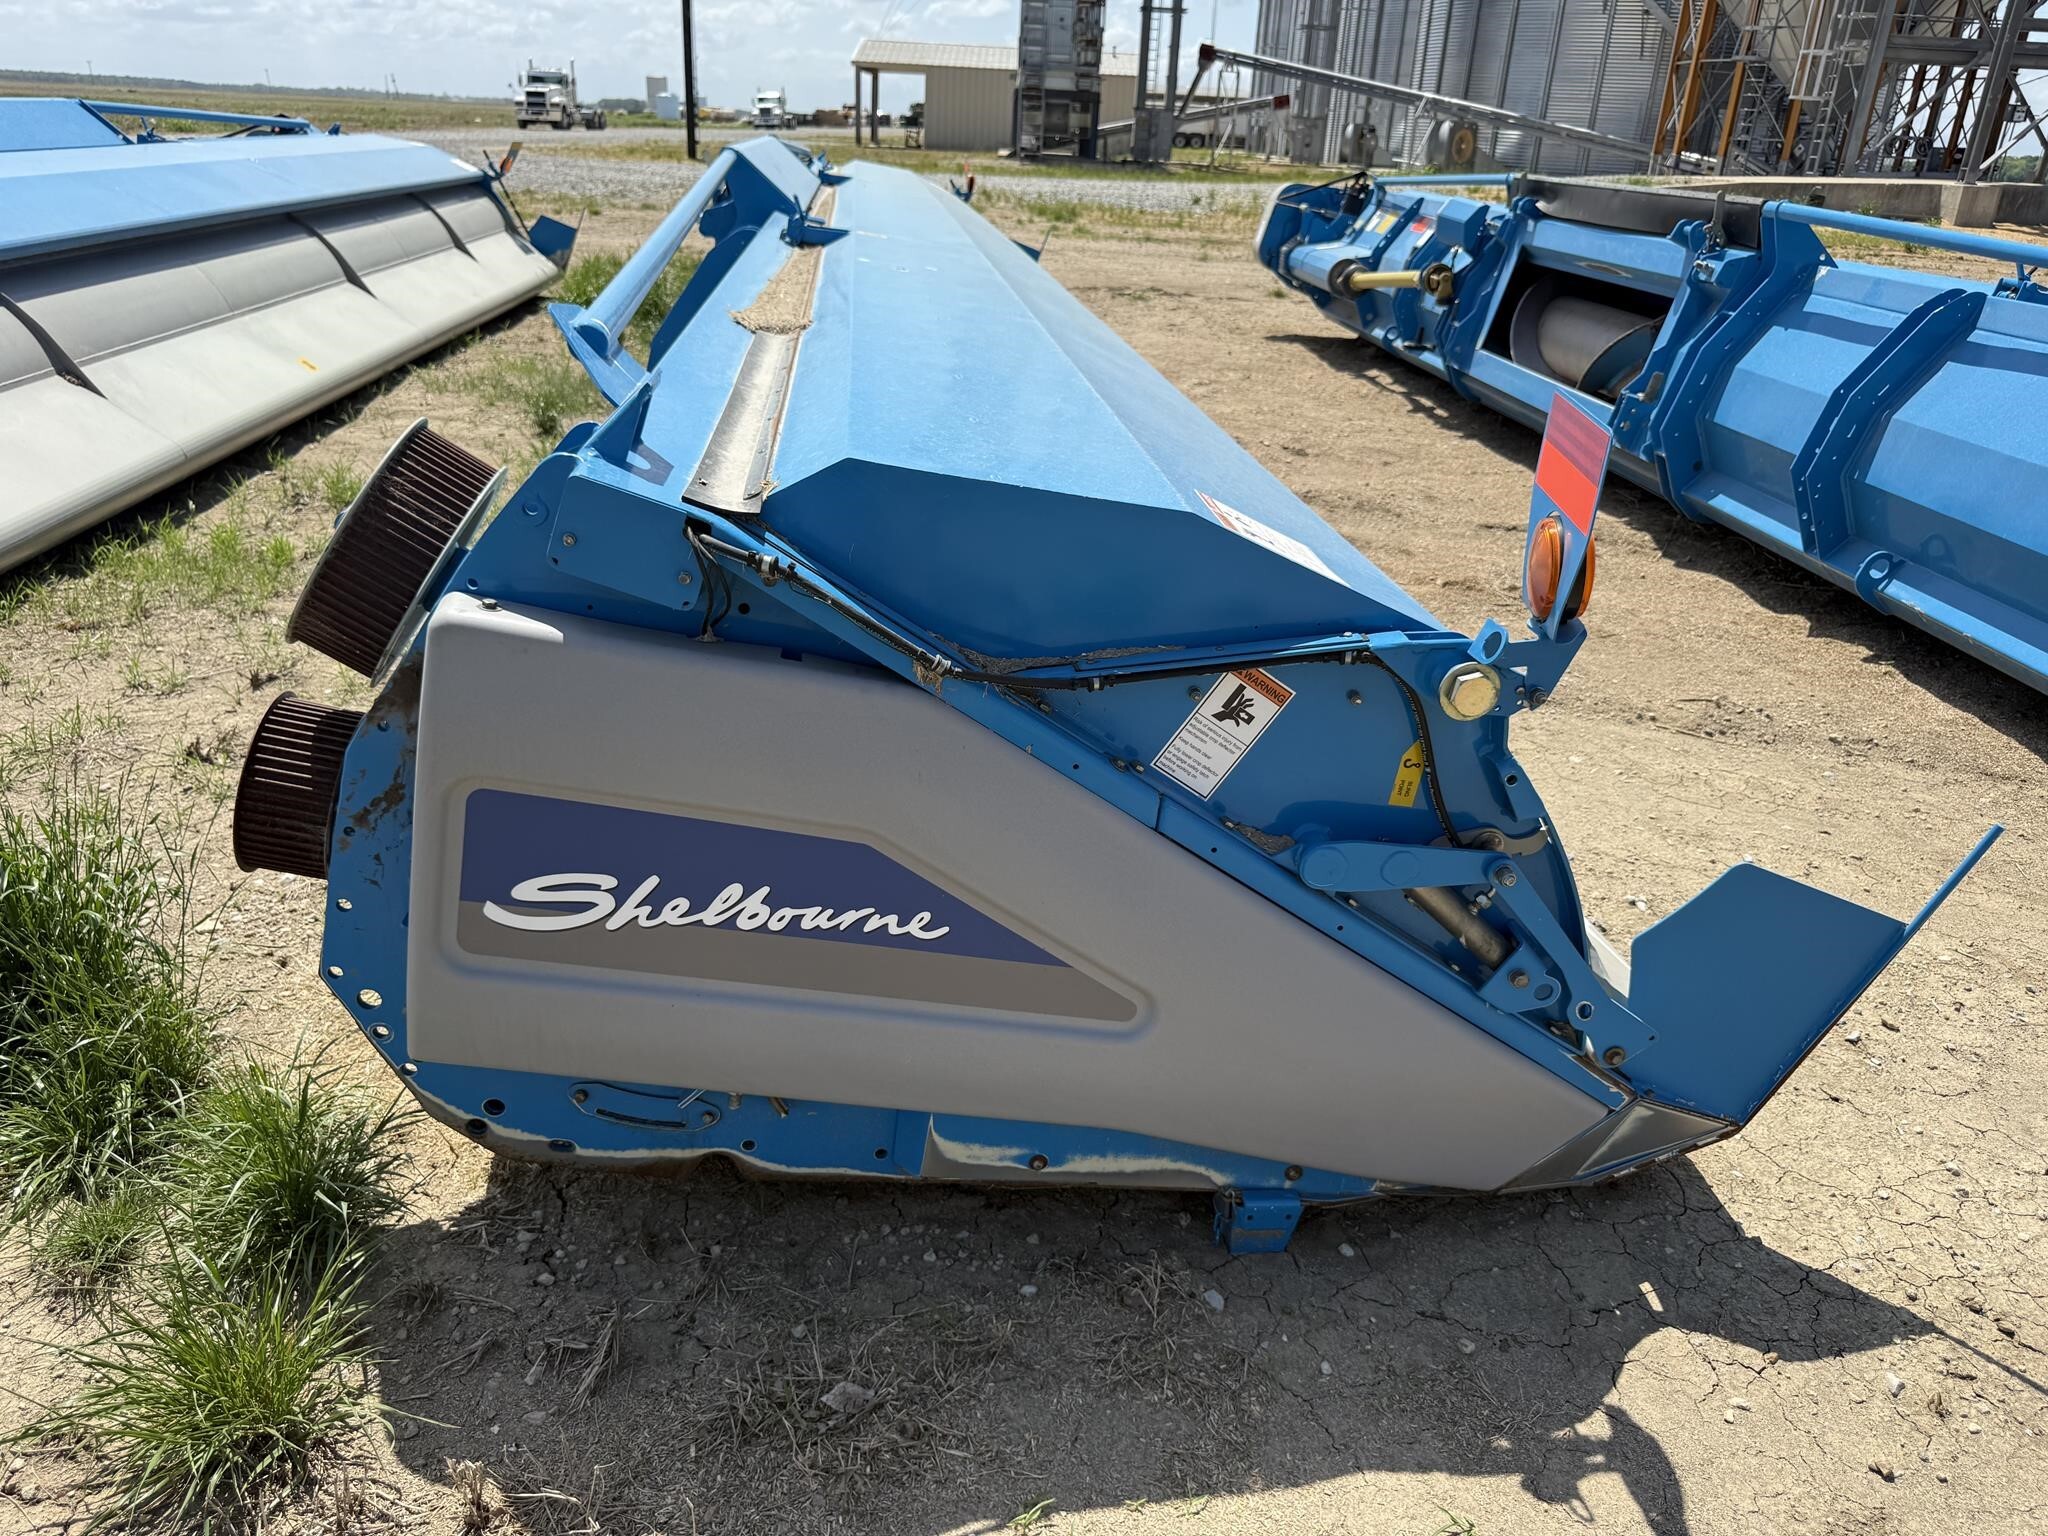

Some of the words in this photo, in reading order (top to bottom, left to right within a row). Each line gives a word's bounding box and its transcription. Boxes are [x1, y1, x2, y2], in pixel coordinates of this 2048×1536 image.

[1244, 669, 1287, 703] WARNING
[1184, 727, 1207, 744] mechanism
[1192, 716, 1203, 724] Risk
[1206, 726, 1222, 737] serious
[1220, 735, 1233, 745] injury
[1232, 742, 1243, 751] from
[1208, 735, 1218, 744] crop
[1217, 741, 1235, 755] deflector
[1170, 743, 1182, 753] Fully
[1181, 750, 1193, 760] lower
[1191, 758, 1202, 766] crop
[1201, 763, 1219, 777] deflector
[1177, 735, 1189, 745] Keep
[1188, 742, 1202, 753] hands
[1200, 751, 1212, 760] clear
[1162, 754, 1176, 765] before
[1174, 763, 1191, 776] working
[1170, 752, 1187, 765] engage
[1186, 762, 1200, 773] safety
[1198, 770, 1209, 779] latch
[483, 872, 950, 940] Shelbourne
